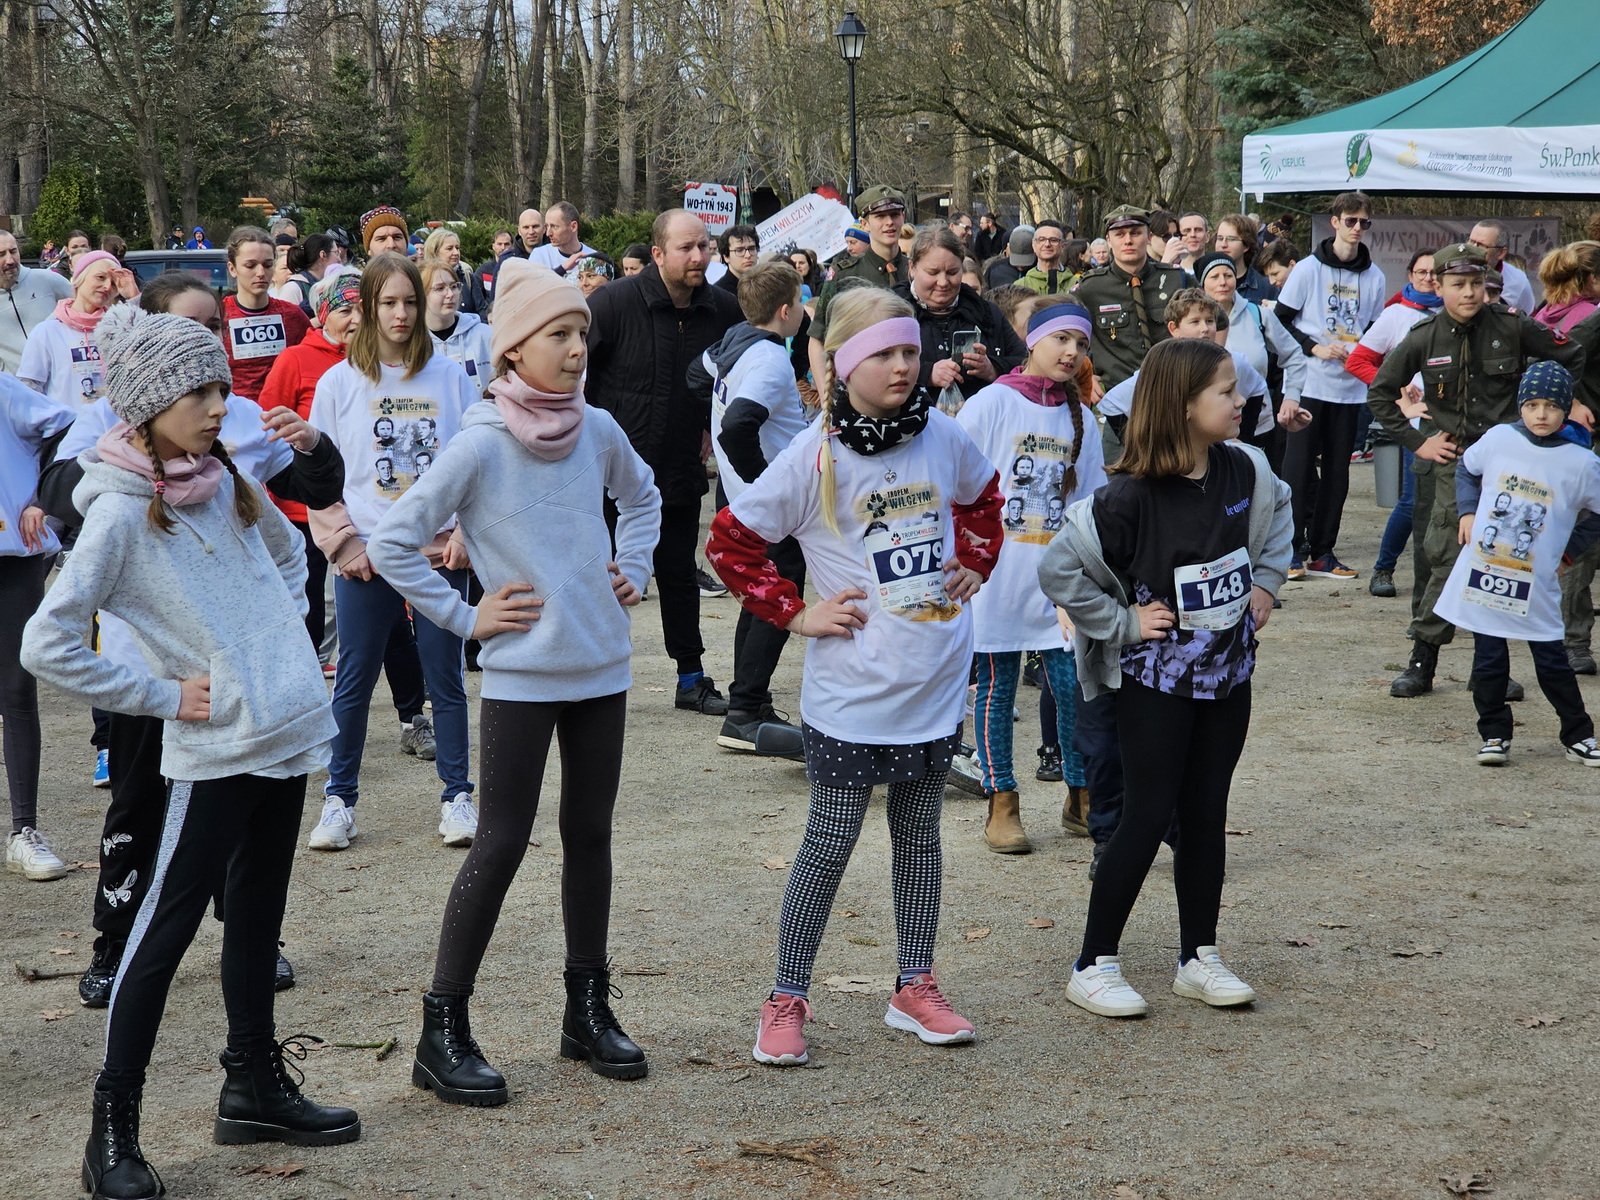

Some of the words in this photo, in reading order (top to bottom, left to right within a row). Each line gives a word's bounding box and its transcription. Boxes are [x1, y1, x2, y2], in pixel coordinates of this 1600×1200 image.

[1281, 156, 1305, 168] CIEPLICE
[717, 201, 734, 212] 1943
[241, 325, 278, 343] 060
[396, 403, 430, 411] WILCZYM
[1038, 443, 1068, 454] WILCZYM
[887, 487, 909, 498] TROPEM
[1519, 484, 1548, 498] WILCZYM
[888, 490, 932, 510] WILCZYM
[889, 541, 943, 578] 079
[1196, 571, 1244, 607] 148
[1479, 574, 1519, 598] 091
